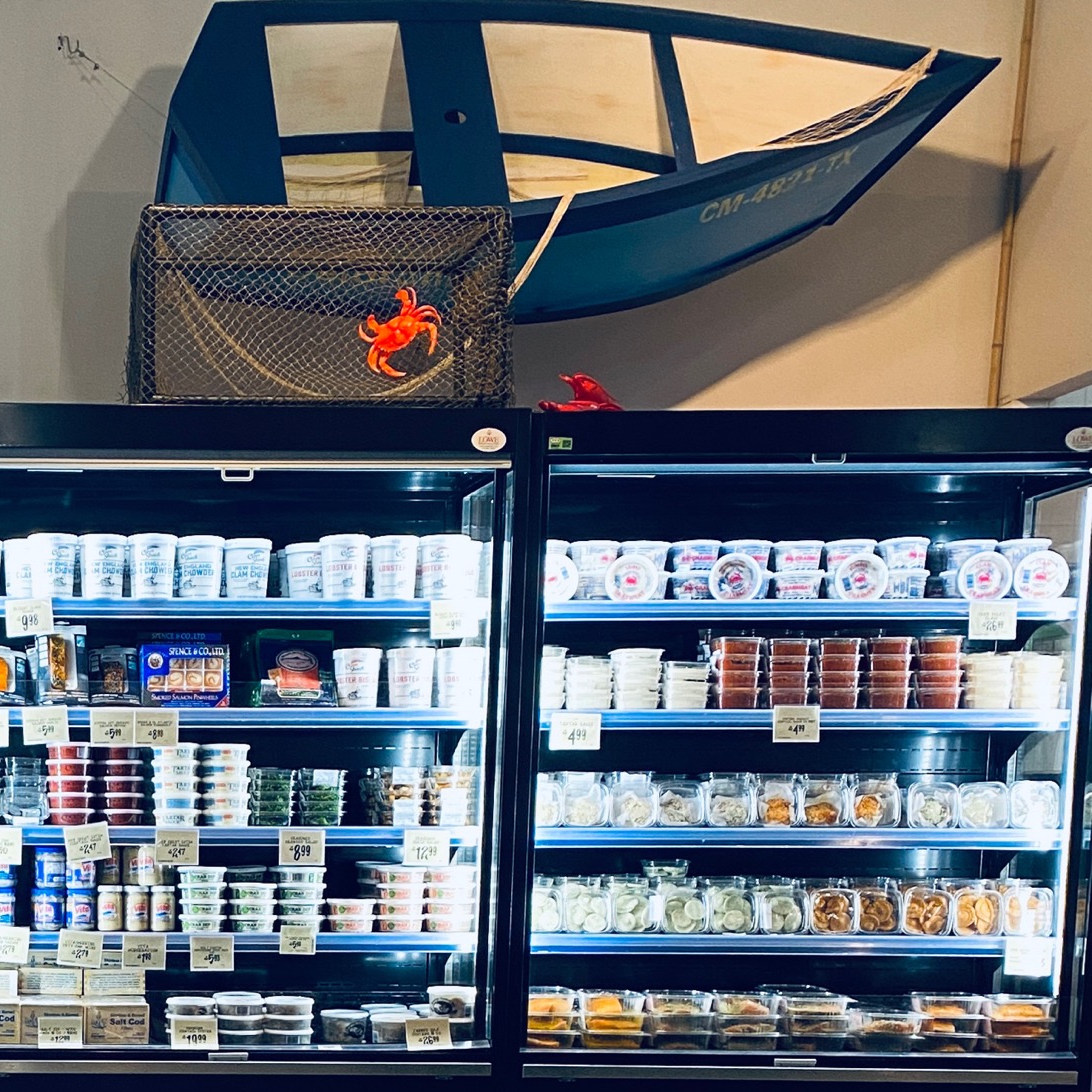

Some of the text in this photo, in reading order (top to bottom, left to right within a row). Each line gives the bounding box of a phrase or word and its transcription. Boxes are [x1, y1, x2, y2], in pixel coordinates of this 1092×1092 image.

[151, 632, 174, 640] SPENCE
[168, 647, 193, 656] SPENCE
[109, 1017, 146, 1026] Salt Cod
